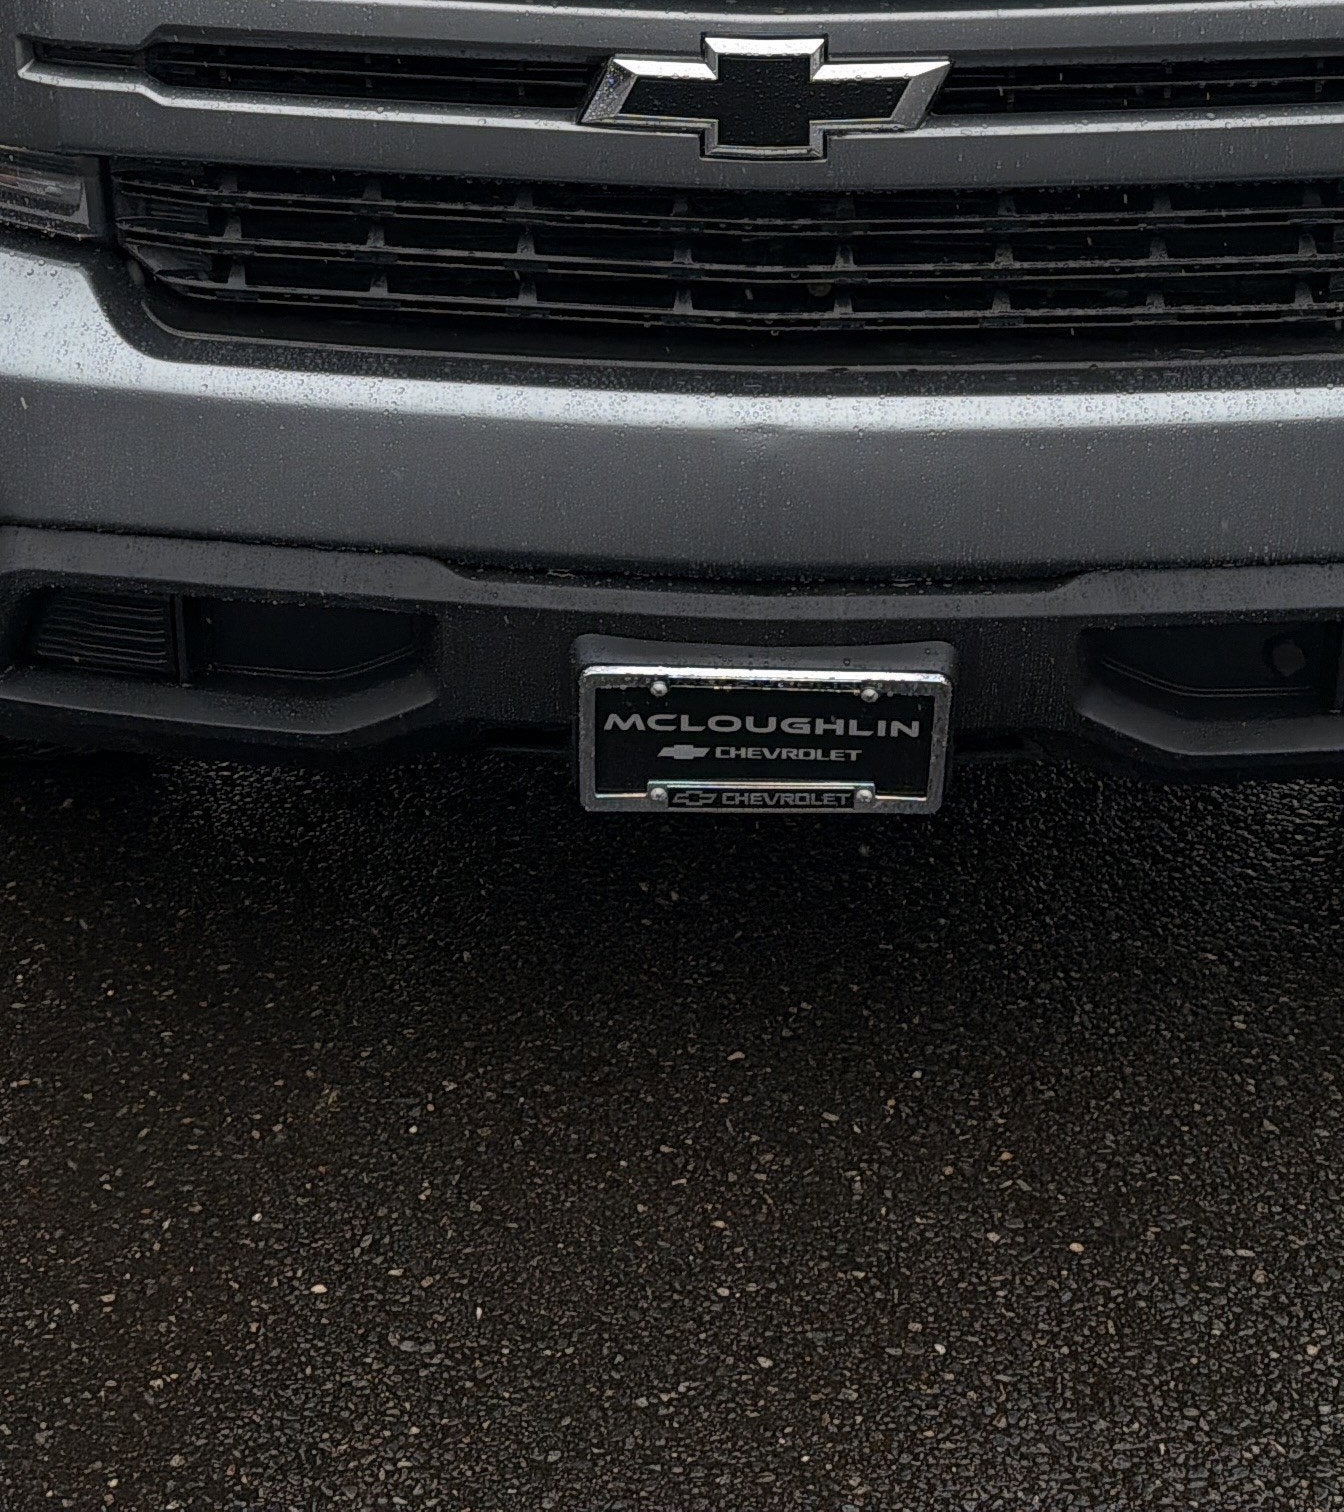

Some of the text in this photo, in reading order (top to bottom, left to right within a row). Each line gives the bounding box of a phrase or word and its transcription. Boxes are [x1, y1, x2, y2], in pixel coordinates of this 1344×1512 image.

[603, 713, 920, 738] MCLOUGHLIN
[715, 746, 862, 761] CHEVROLET
[721, 792, 852, 807] CHEVROLET
